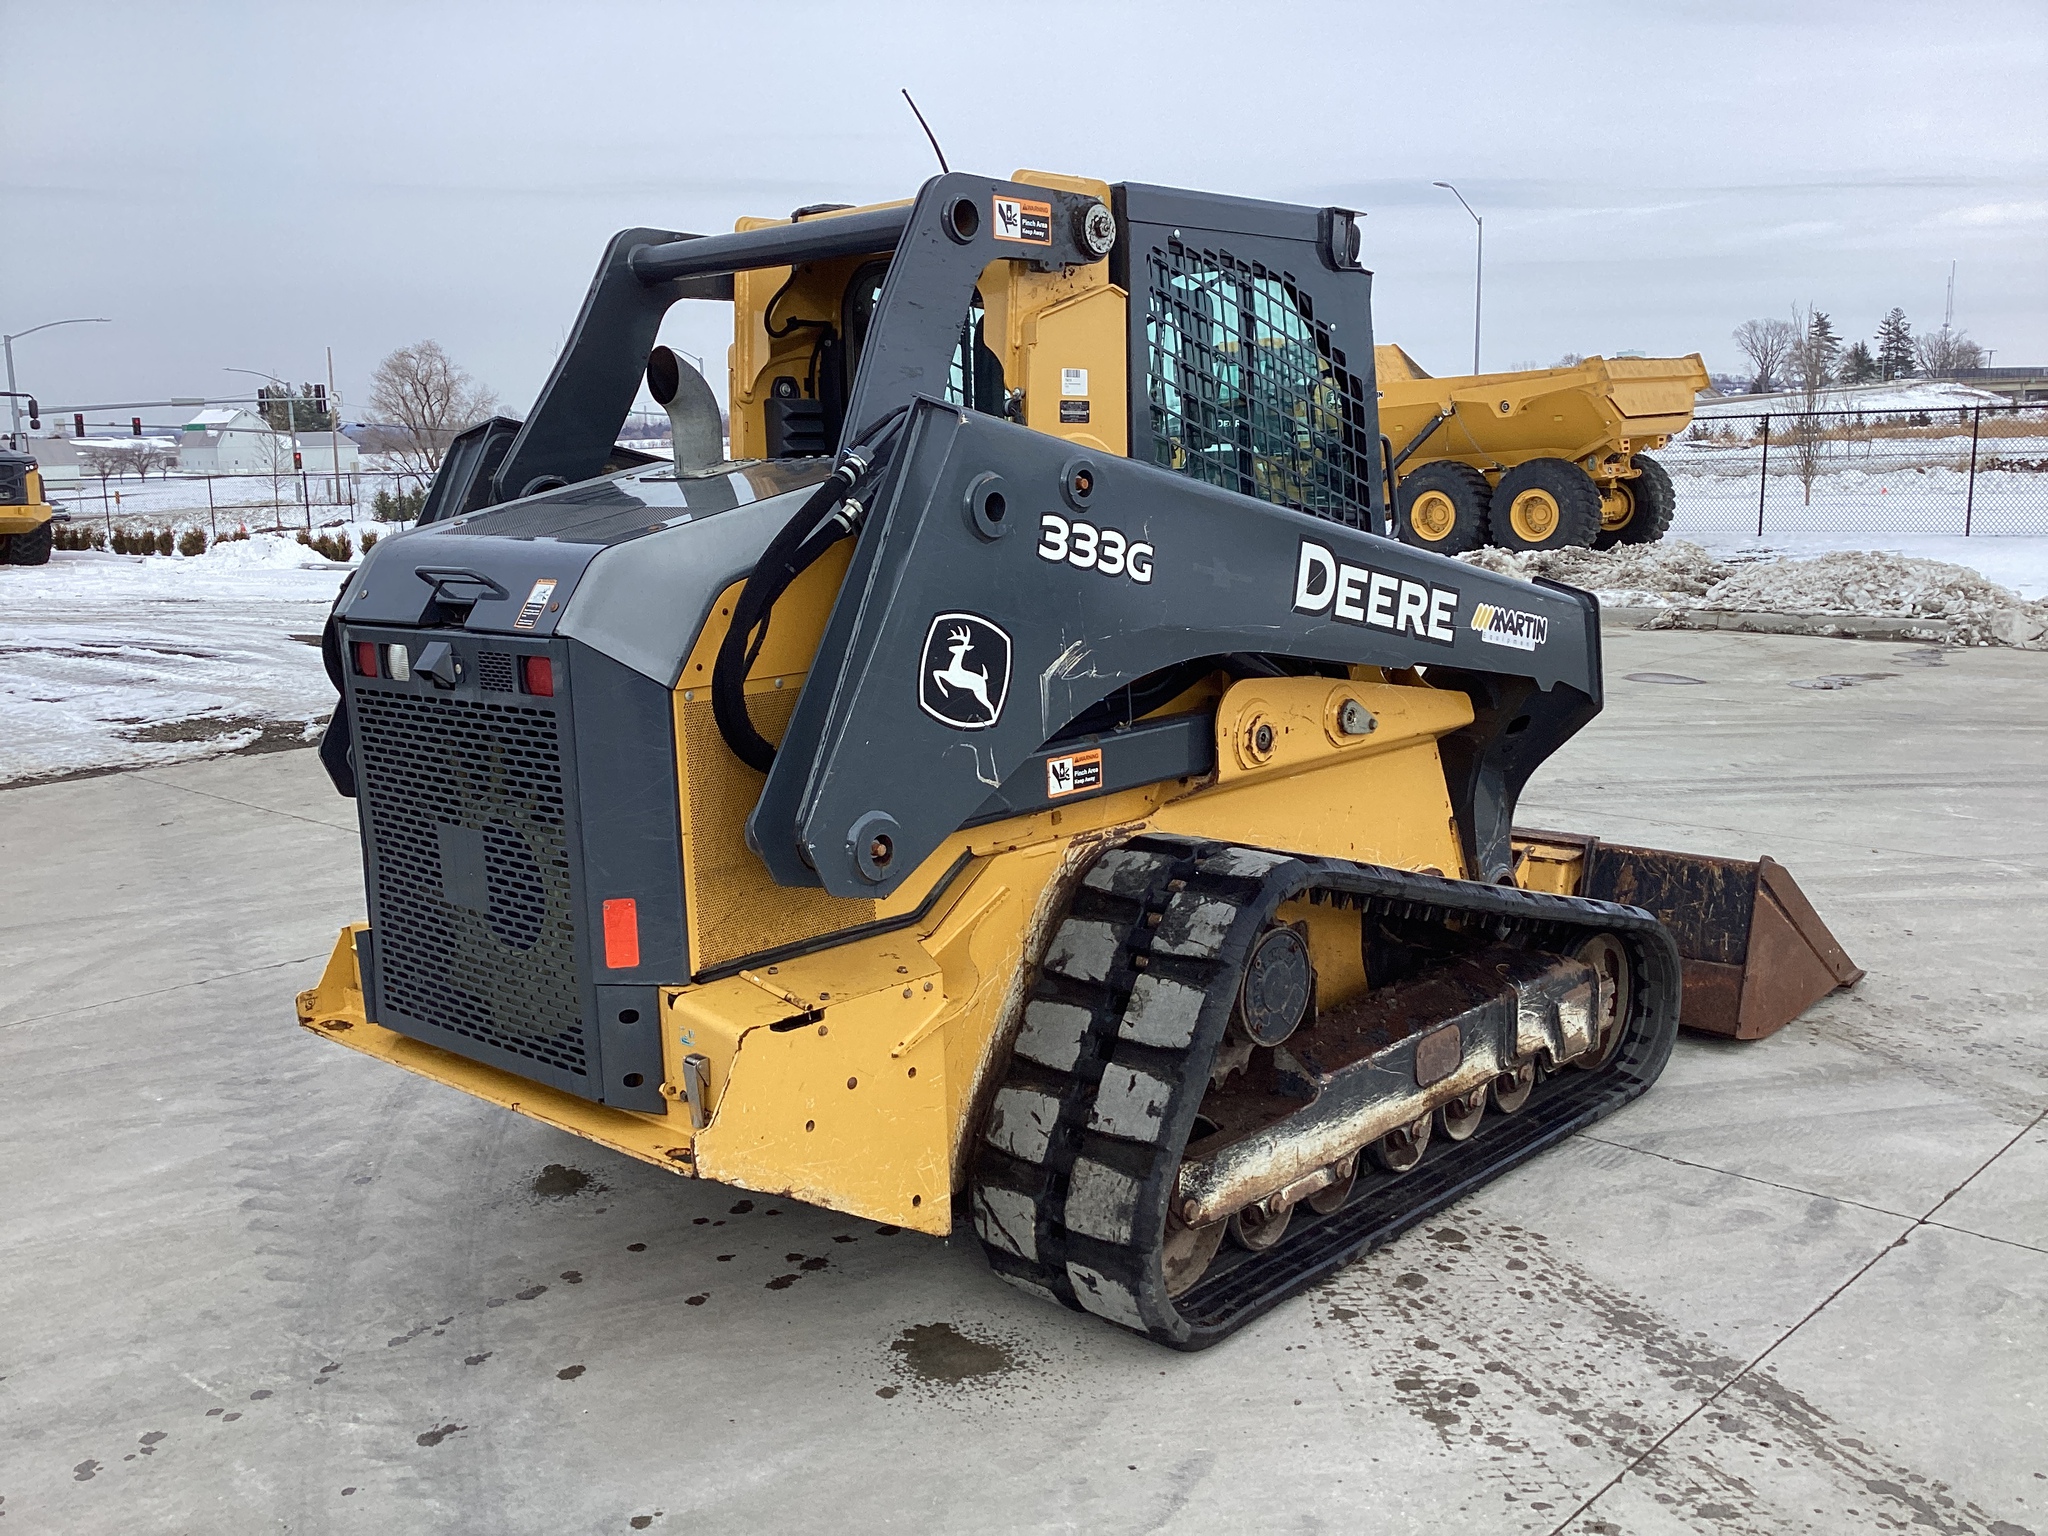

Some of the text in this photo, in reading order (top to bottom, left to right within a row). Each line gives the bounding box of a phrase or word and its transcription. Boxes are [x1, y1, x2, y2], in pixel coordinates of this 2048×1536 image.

[1022, 219, 1048, 229] Pinch Area
[1022, 228, 1033, 236] Keep
[1038, 514, 1154, 582] 333G
[1296, 541, 1458, 642] DEERE
[1488, 608, 1547, 642] MARTIN
[1078, 753, 1099, 761] WARNING
[1074, 769, 1087, 777] Pinch
